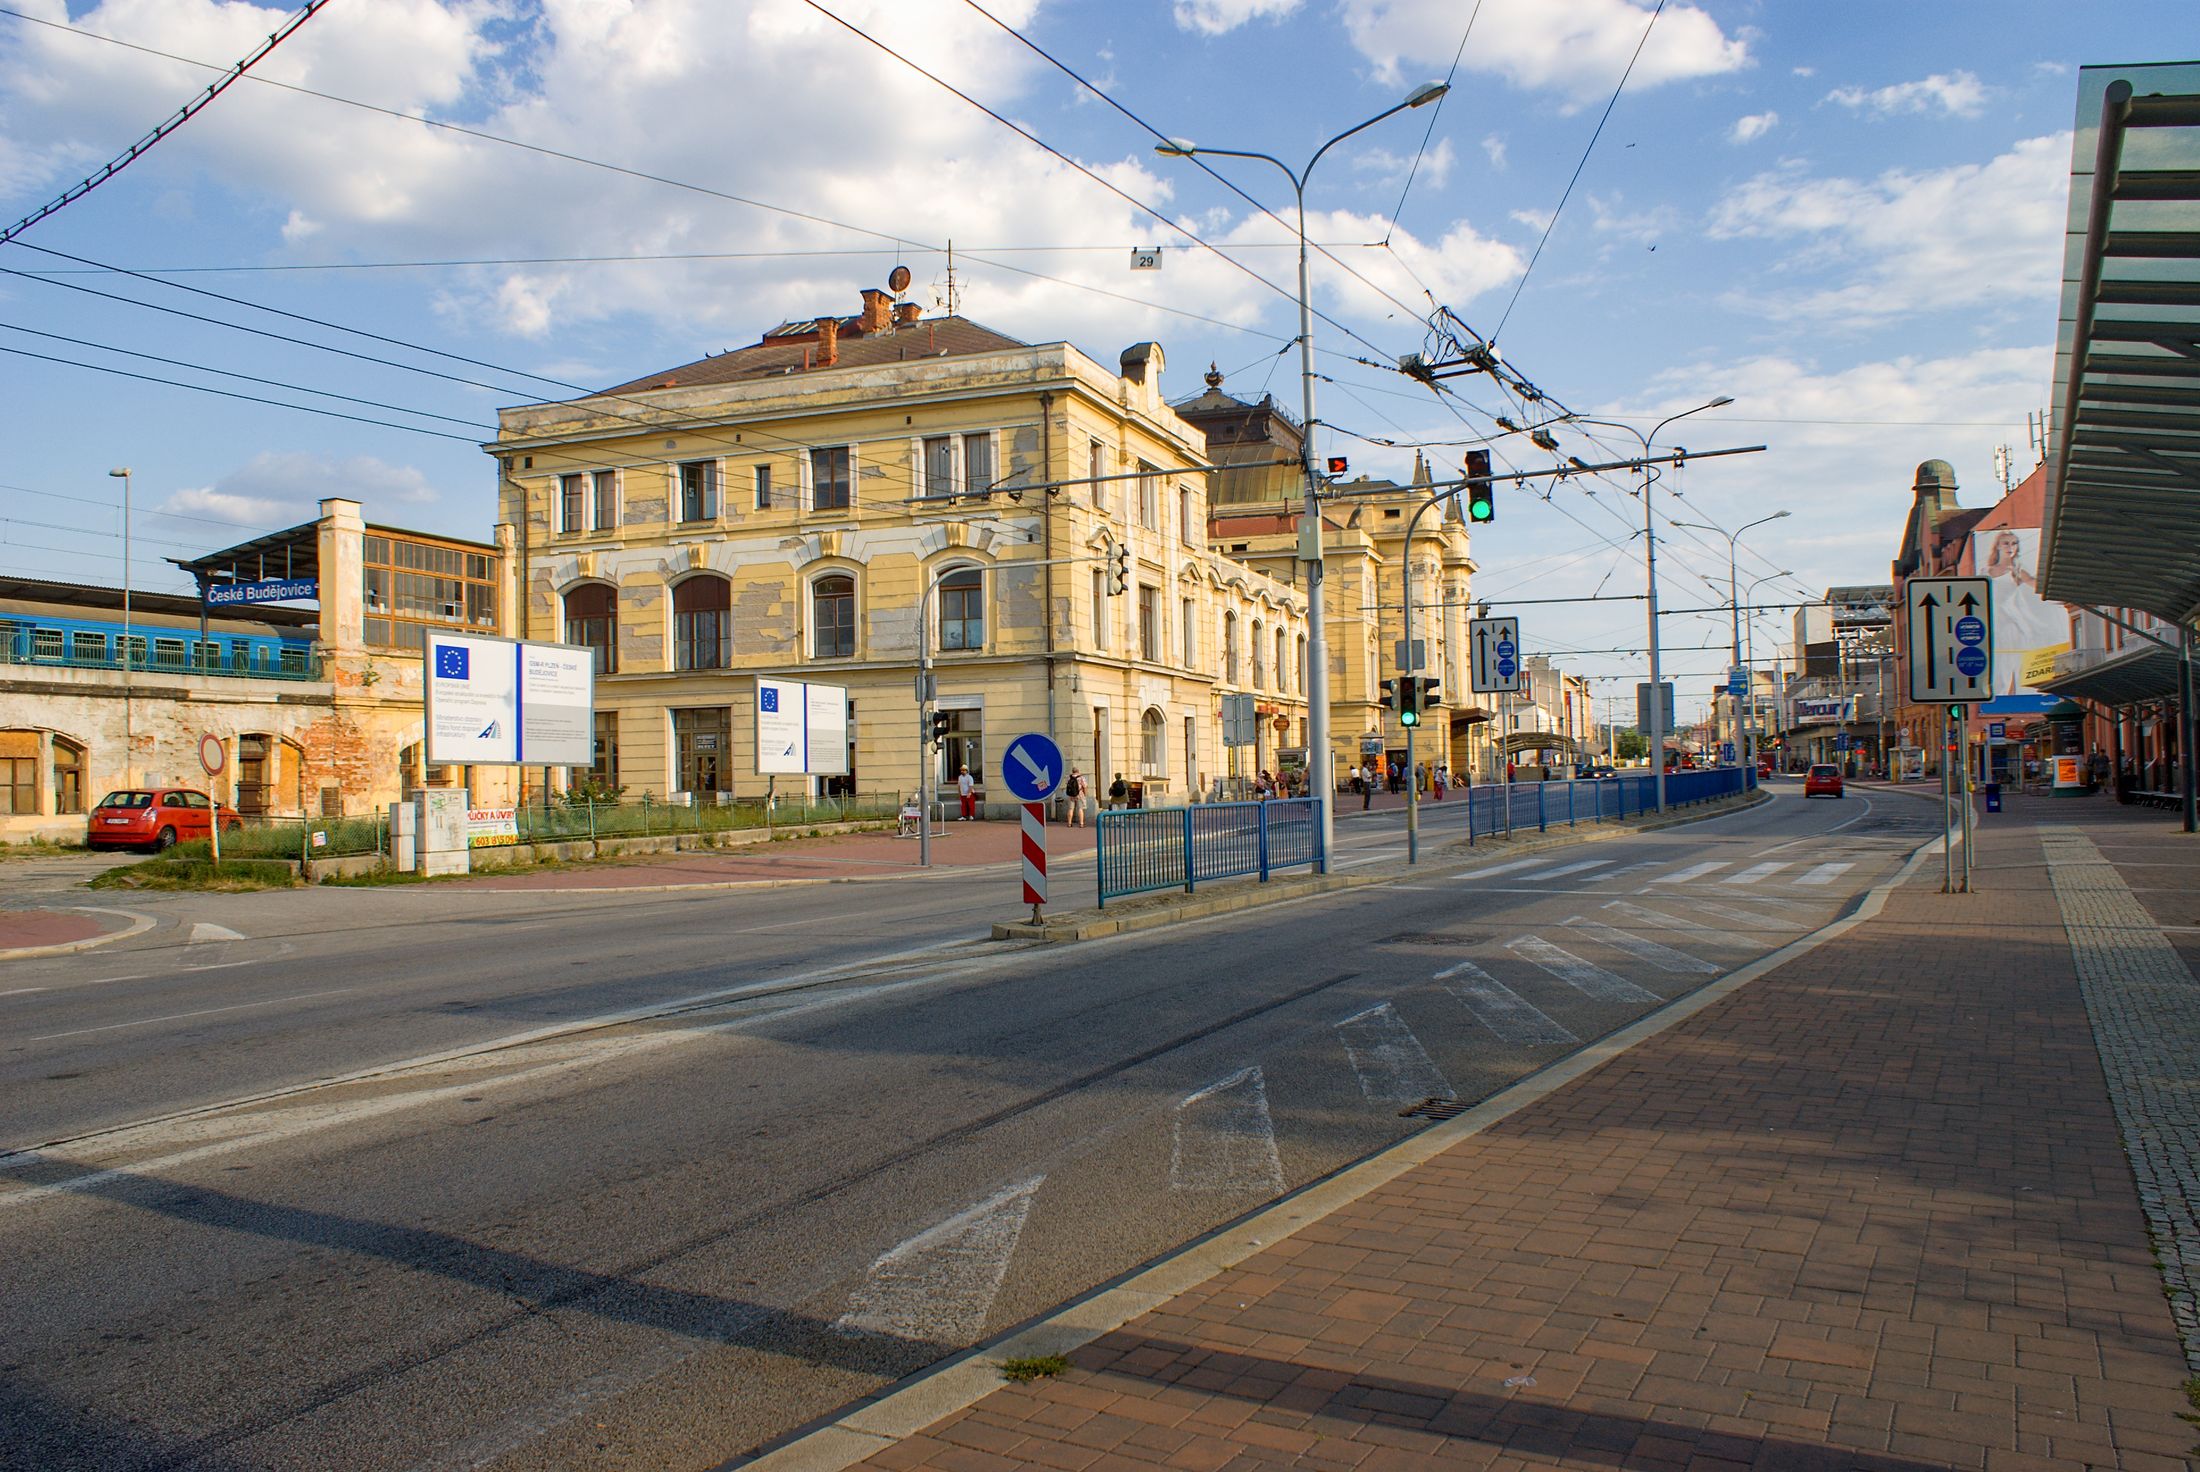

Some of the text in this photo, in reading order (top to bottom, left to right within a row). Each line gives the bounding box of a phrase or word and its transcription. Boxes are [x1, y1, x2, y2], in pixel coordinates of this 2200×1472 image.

[1139, 256, 1154, 267] 29
[208, 583, 312, 603] České Budějovice
[475, 836, 489, 846] 603
